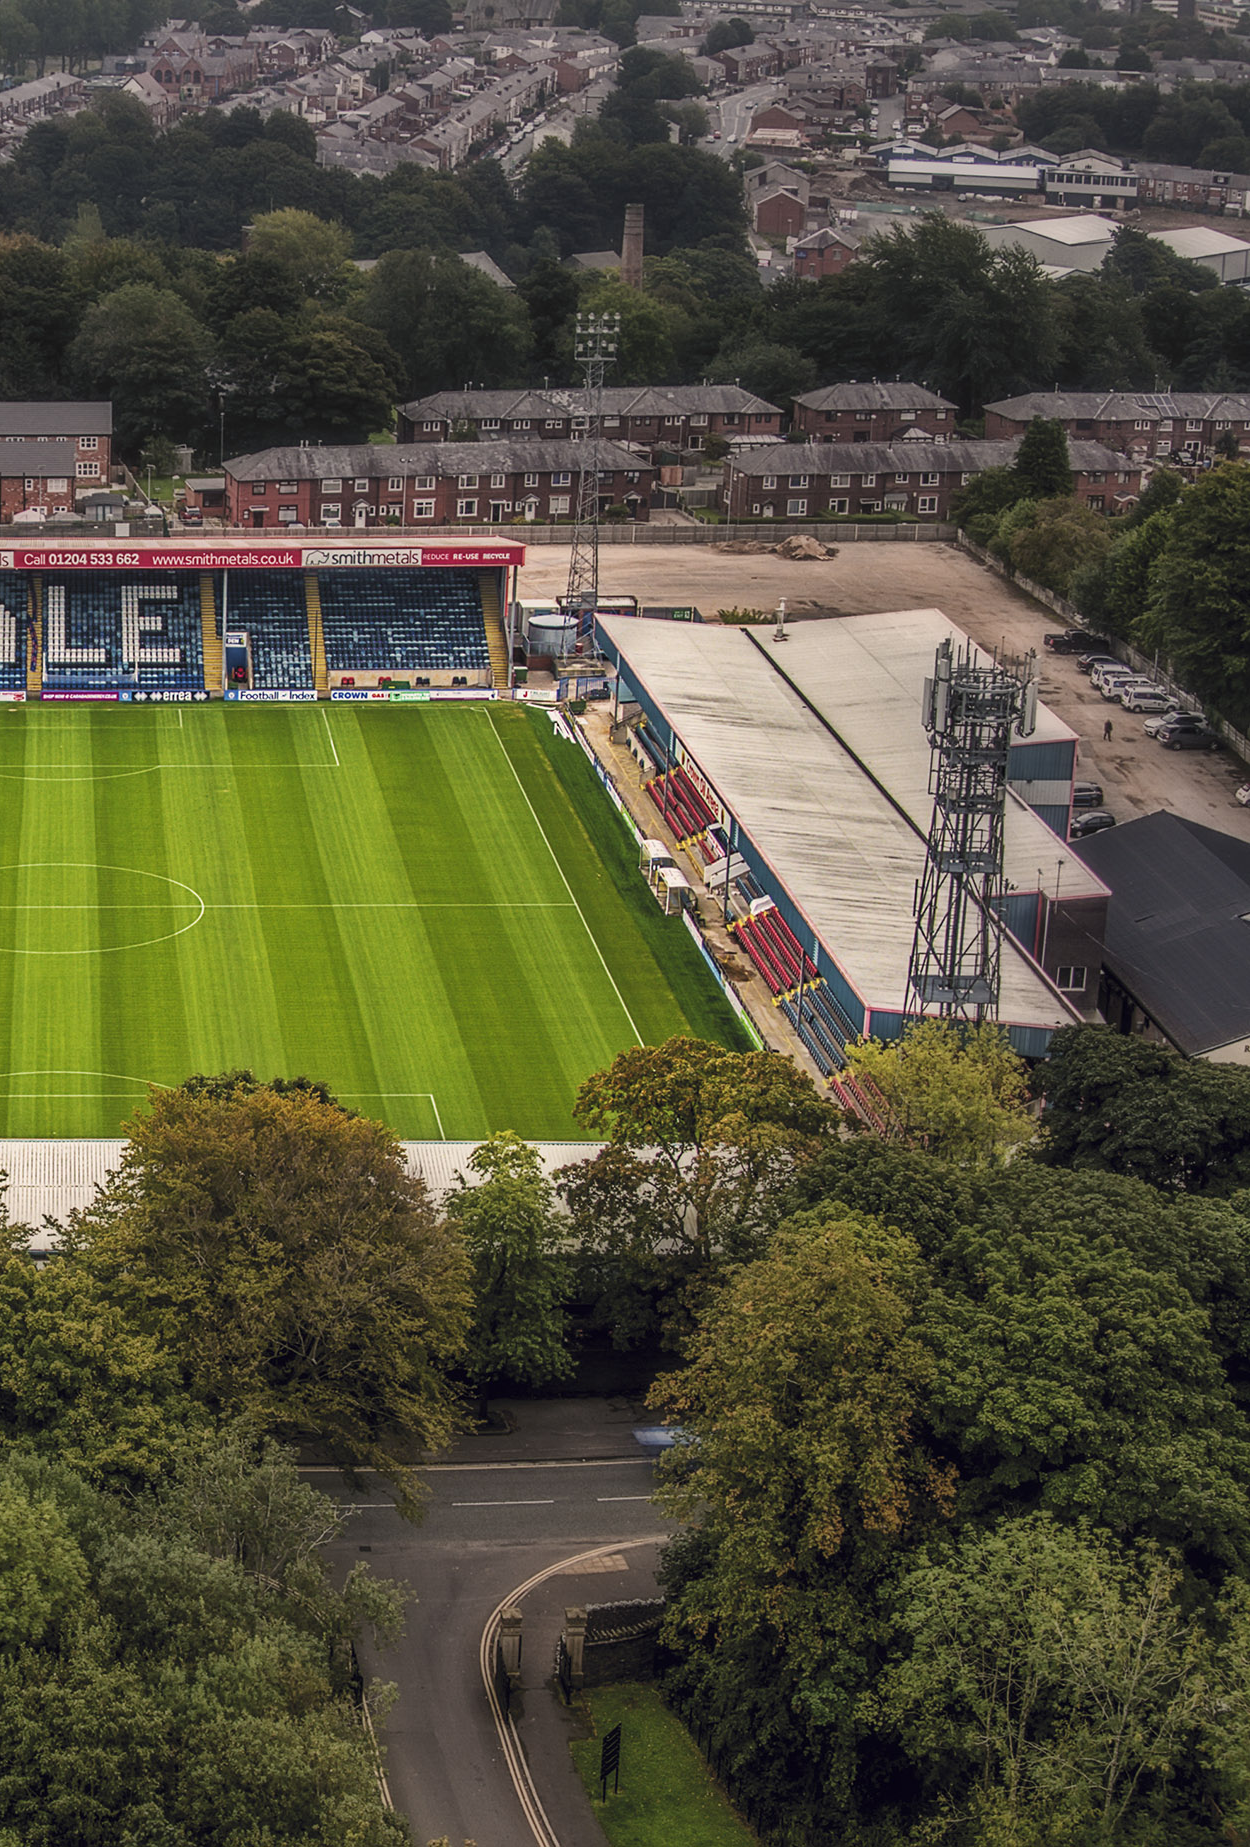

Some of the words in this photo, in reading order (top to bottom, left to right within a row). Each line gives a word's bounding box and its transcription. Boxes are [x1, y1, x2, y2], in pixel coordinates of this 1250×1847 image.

[24, 553, 46, 565] Call
[49, 553, 87, 565] 01204
[90, 553, 114, 565] 533
[116, 553, 139, 565] 662
[152, 552, 294, 565] www.smithmetals.co.uk
[332, 550, 419, 565] smithmetals
[422, 553, 449, 561] REDUCE
[453, 552, 479, 560] RE-USE
[482, 552, 510, 560] RECYCLE
[240, 691, 279, 700] Football
[290, 691, 315, 700] Index
[686, 758, 700, 788] Crown
[706, 787, 719, 817] Arena
